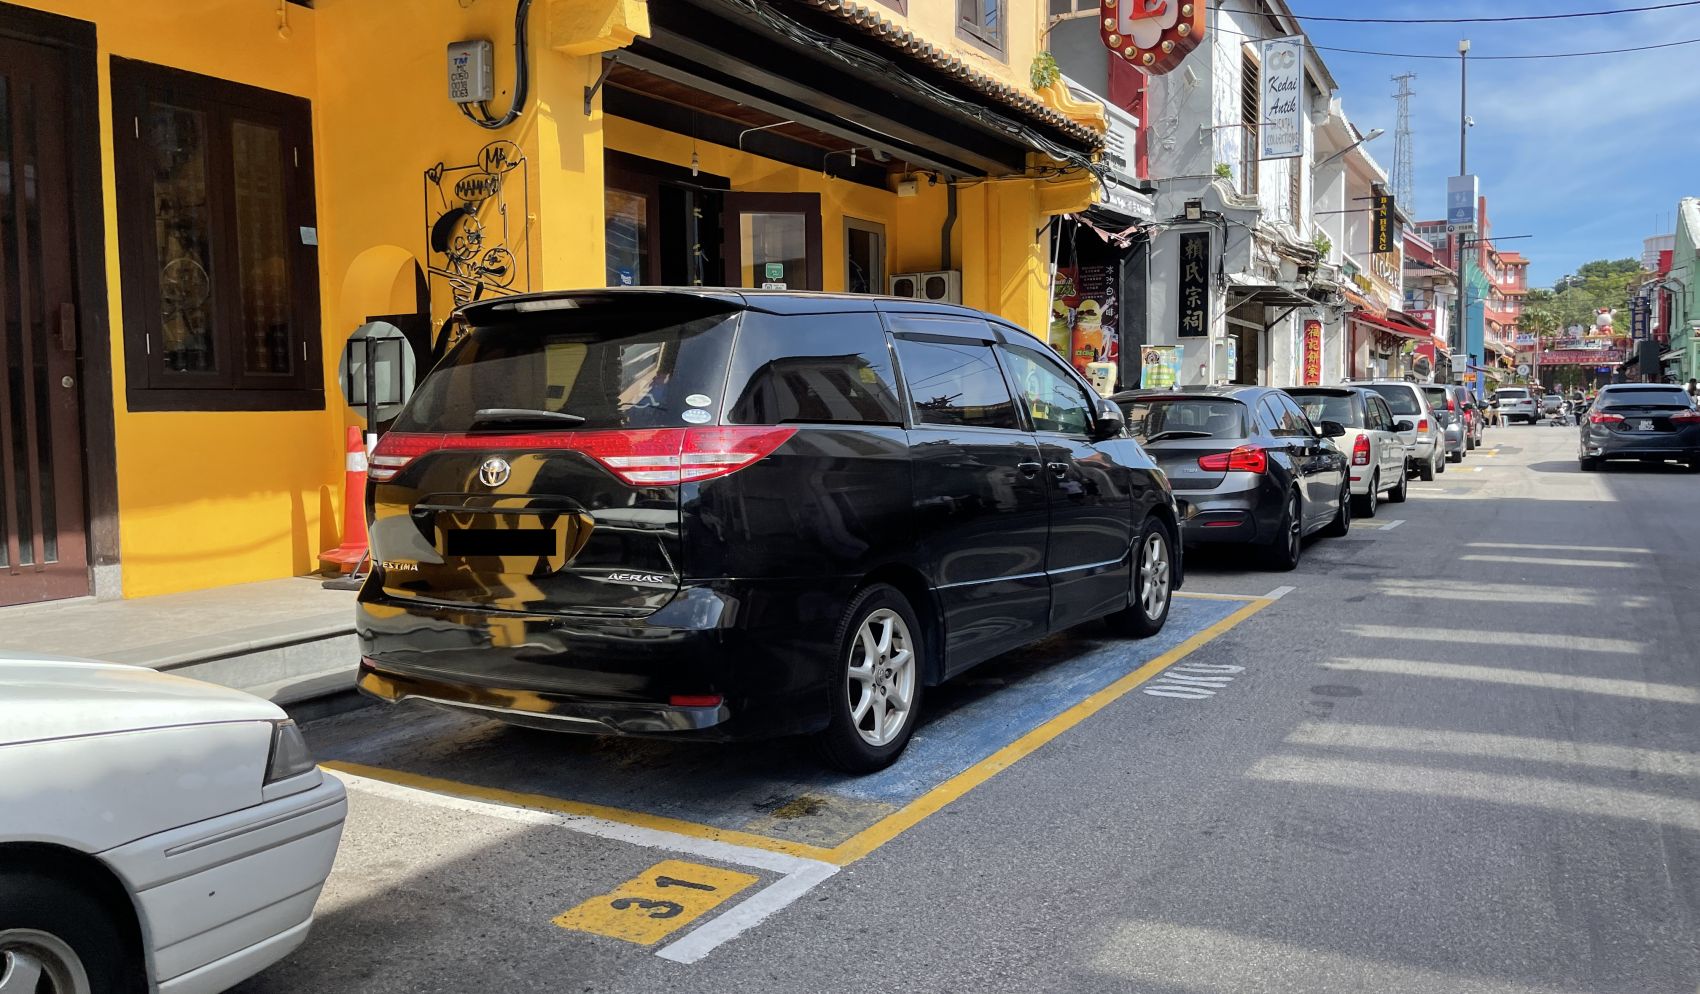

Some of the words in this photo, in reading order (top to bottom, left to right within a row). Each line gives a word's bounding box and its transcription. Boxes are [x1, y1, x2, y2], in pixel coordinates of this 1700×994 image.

[1268, 75, 1298, 93] Kedai
[1269, 96, 1297, 116] Antik
[1379, 218, 1387, 251] HEANG
[382, 561, 419, 572] ESTIMA
[607, 572, 664, 583] AERAS
[611, 875, 717, 919] 31
